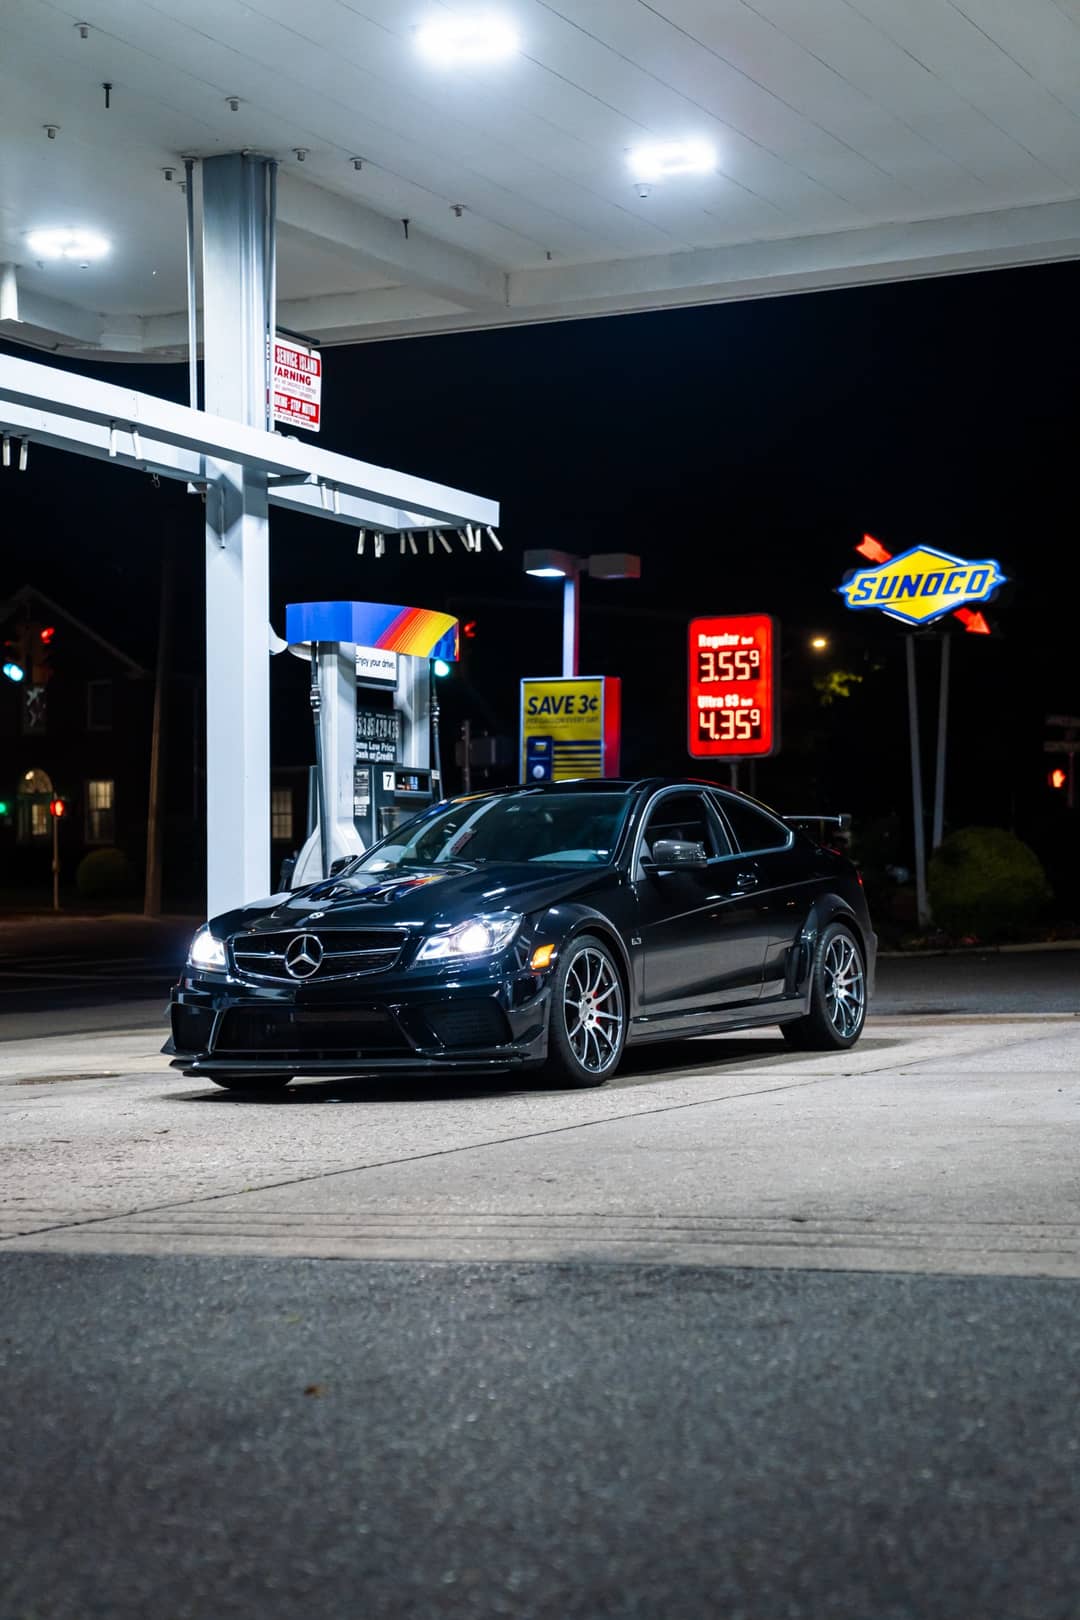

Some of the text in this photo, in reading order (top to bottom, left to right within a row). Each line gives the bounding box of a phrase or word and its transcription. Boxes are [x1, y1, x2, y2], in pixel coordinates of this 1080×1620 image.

[852, 569, 991, 602] SUNOCO
[527, 694, 599, 715] SAVE 3¢
[385, 774, 393, 788] 7
